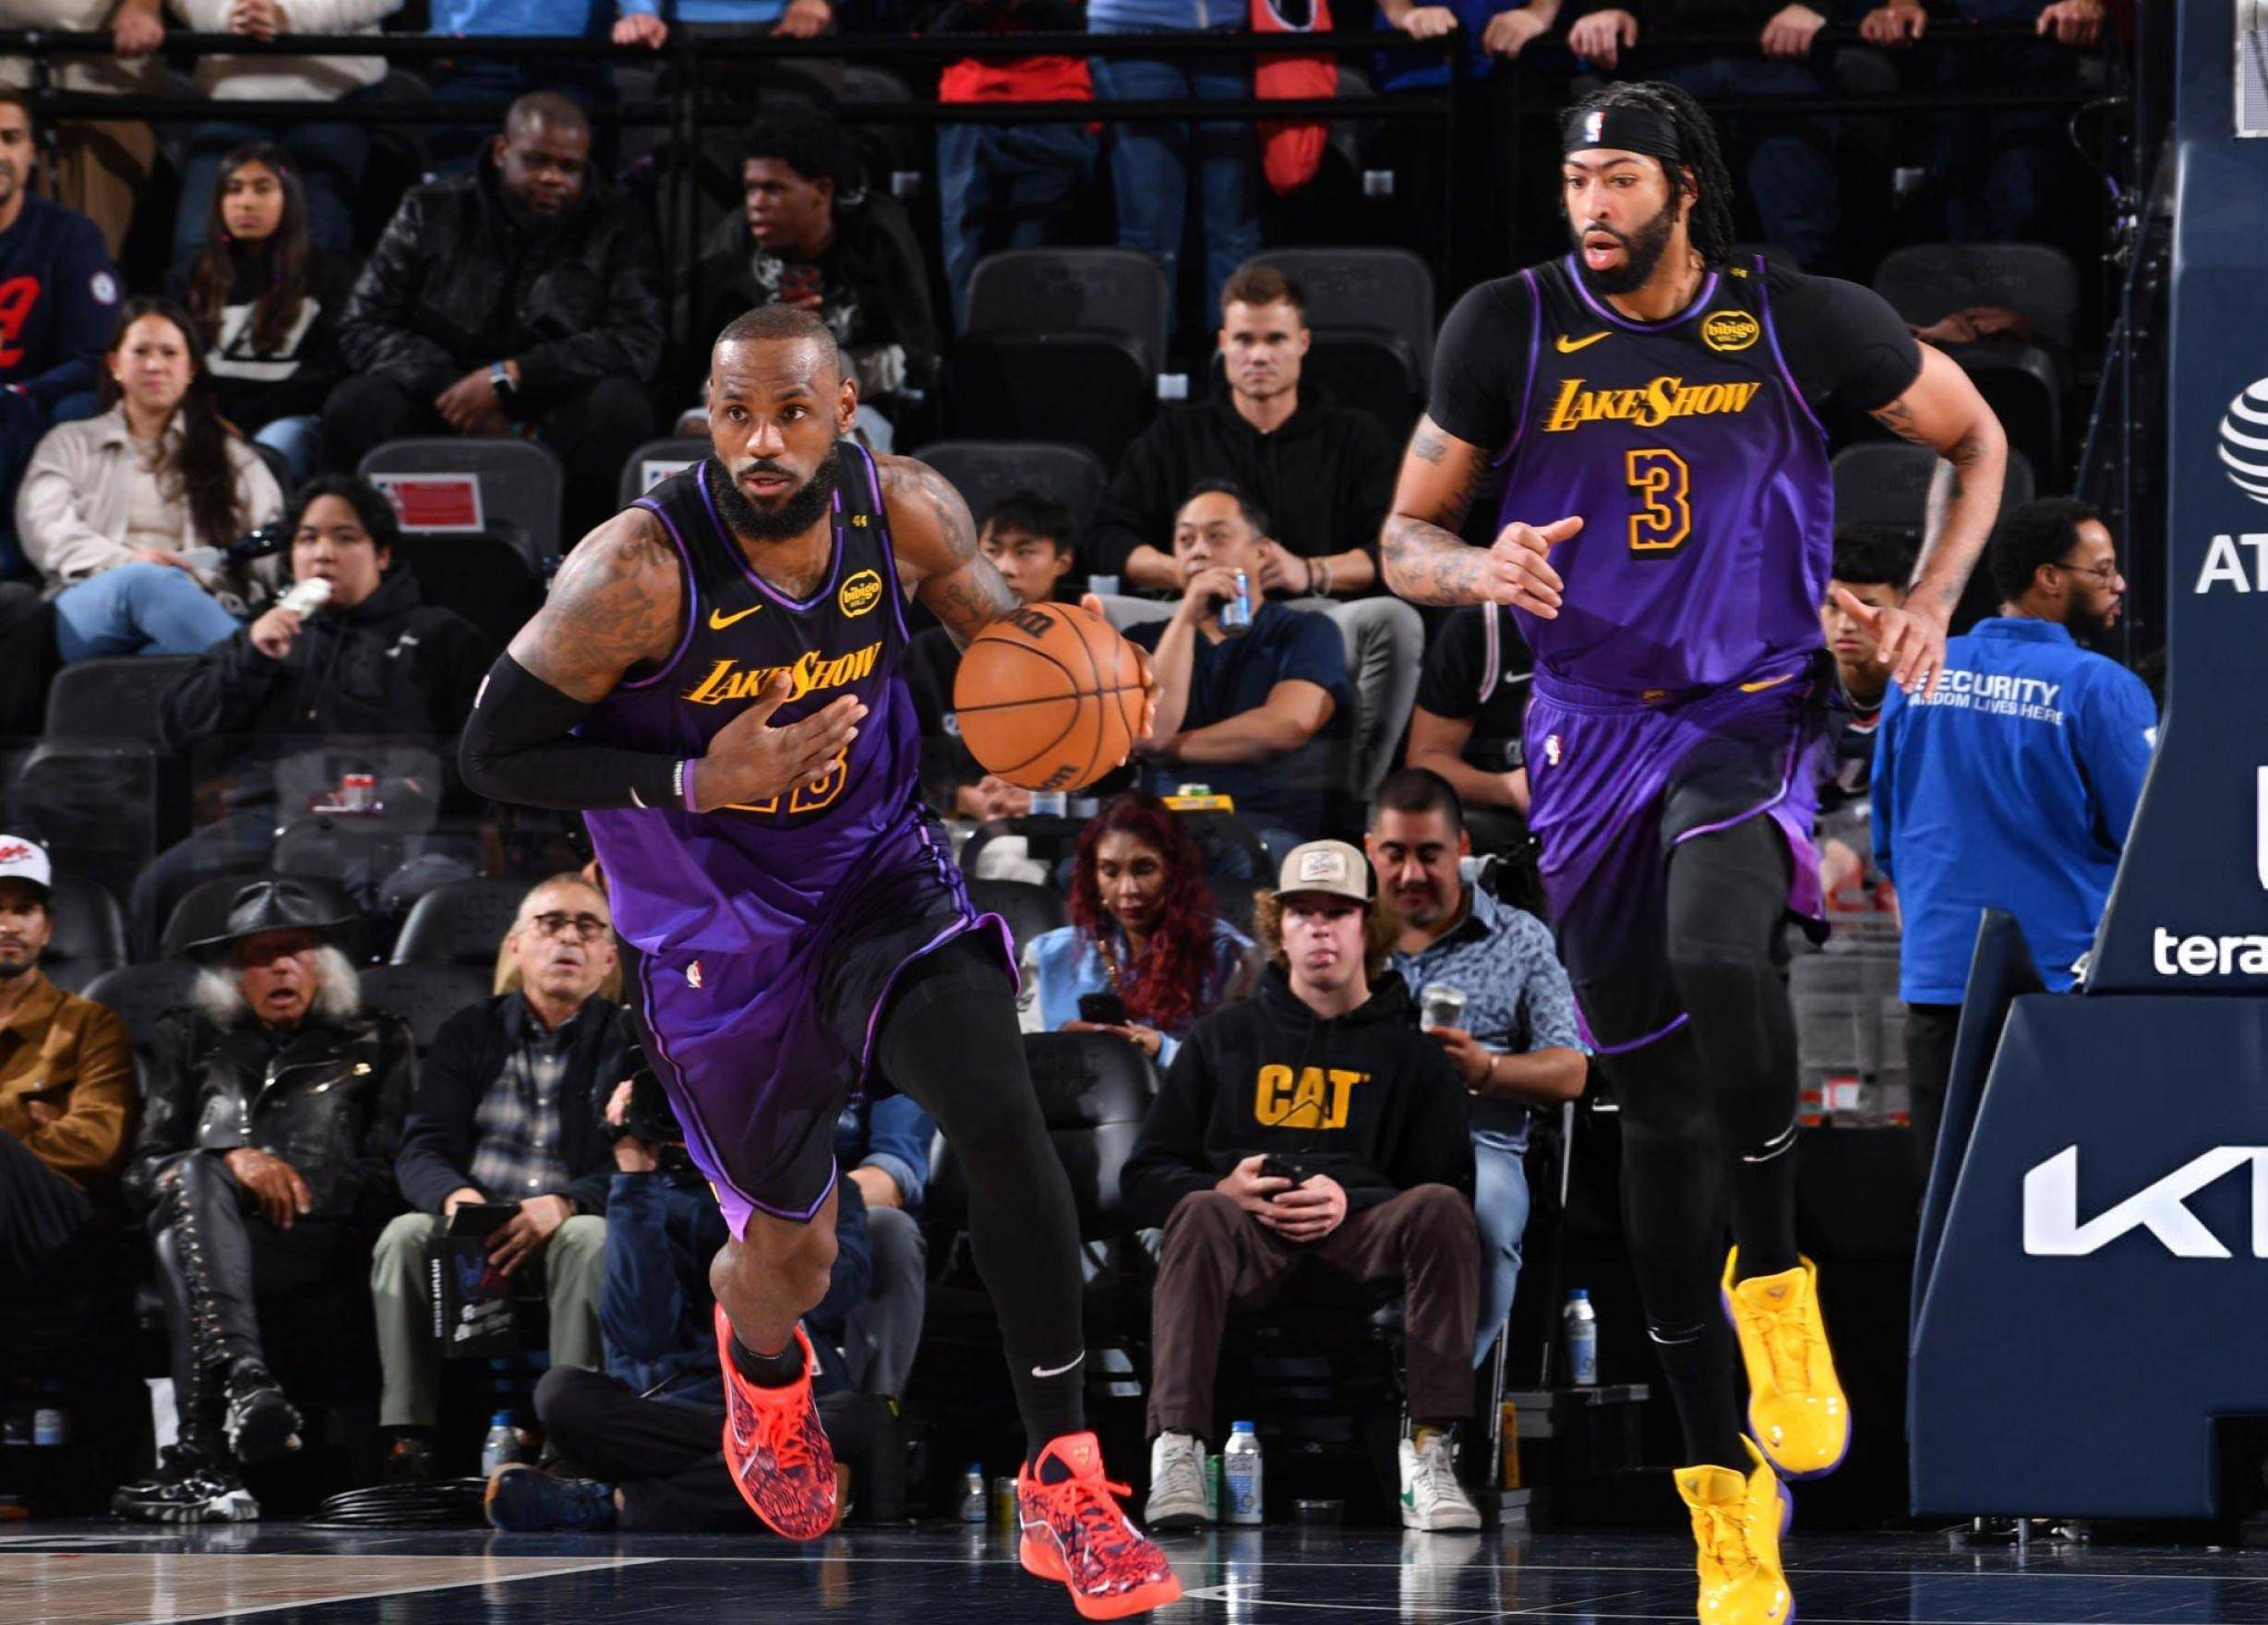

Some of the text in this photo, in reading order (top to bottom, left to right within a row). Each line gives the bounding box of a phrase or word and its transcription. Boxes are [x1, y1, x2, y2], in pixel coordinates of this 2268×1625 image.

[1626, 449, 1691, 551] 3
[1974, 696, 2019, 716] LIVES
[2021, 703, 2064, 726] HERE
[2154, 926, 2268, 976] tera
[1255, 1064, 1362, 1129] CAT
